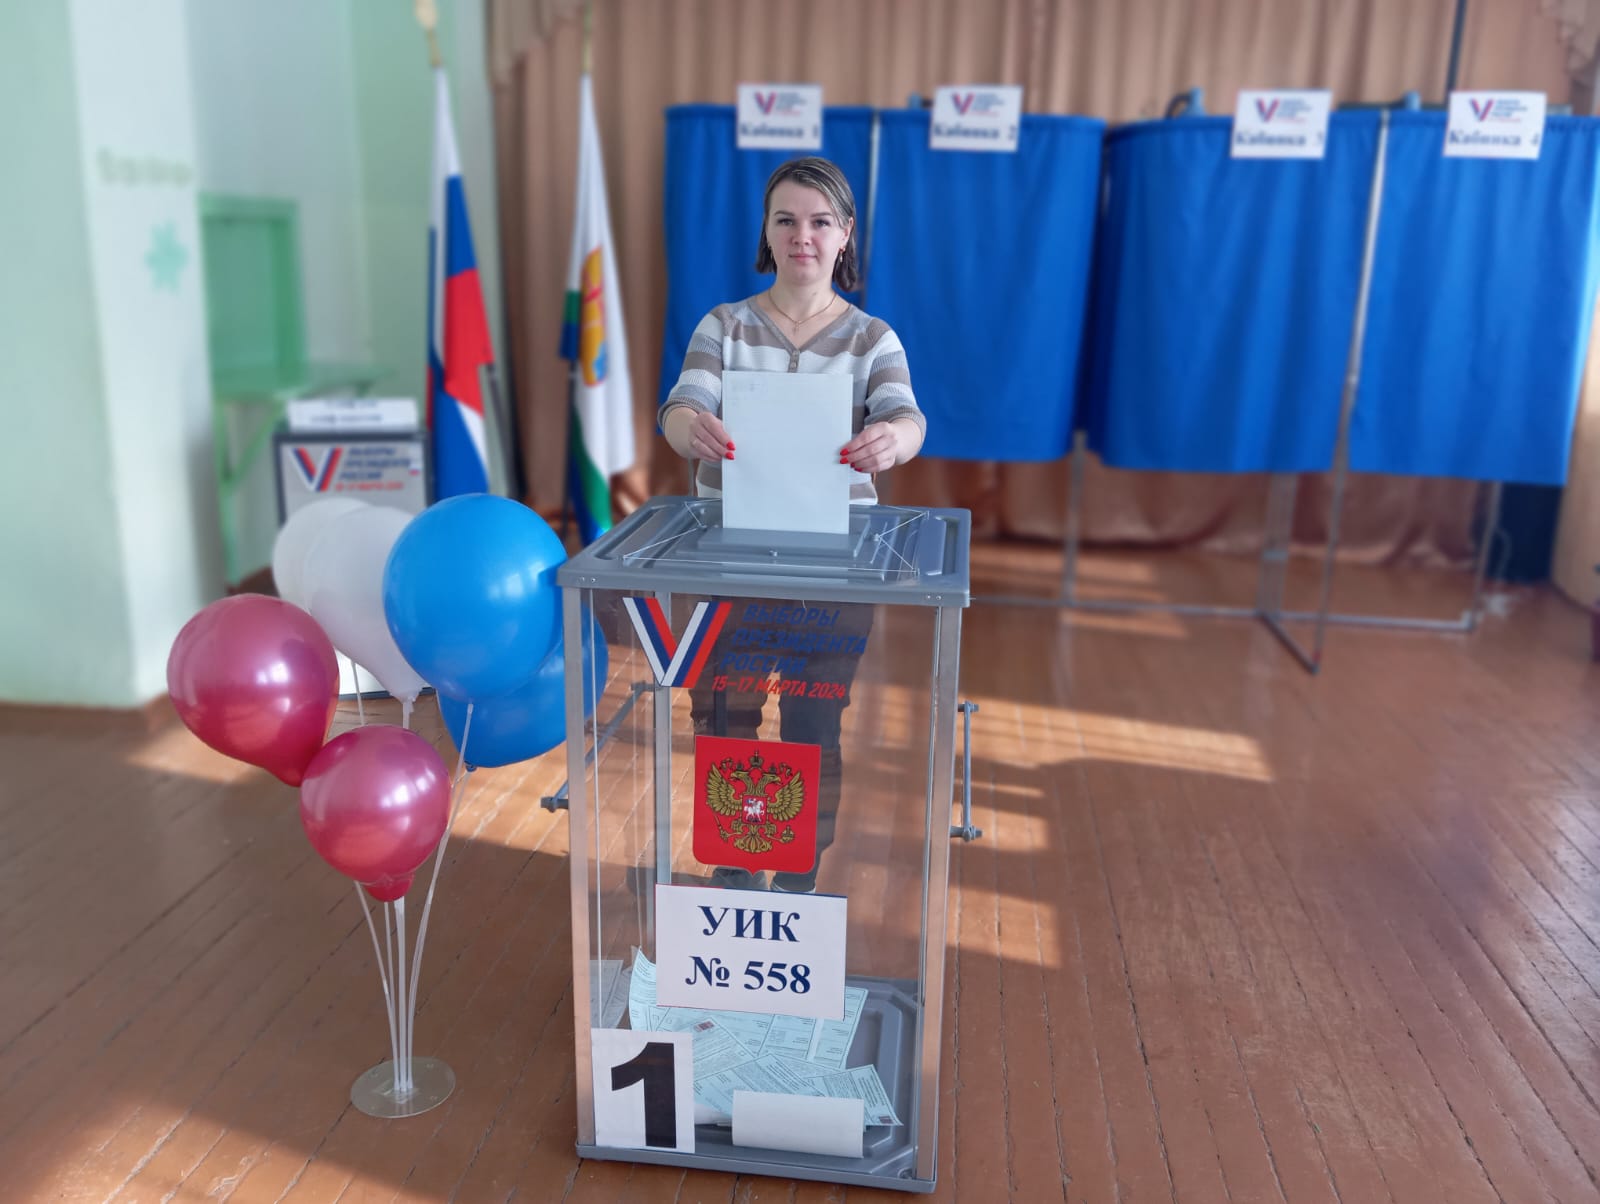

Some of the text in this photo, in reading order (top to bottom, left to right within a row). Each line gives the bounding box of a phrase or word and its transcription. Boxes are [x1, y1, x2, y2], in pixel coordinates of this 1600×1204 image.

[742, 603, 841, 627] ВЫБОРЫ
[730, 628, 867, 655] ПРЕЗИДЕНТА
[720, 652, 808, 676] РОССИИ
[755, 677, 806, 698] МАРТА
[808, 681, 848, 700] 2024
[697, 905, 801, 942] УИК
[685, 955, 811, 994] № 558
[610, 1041, 677, 1148] 1
